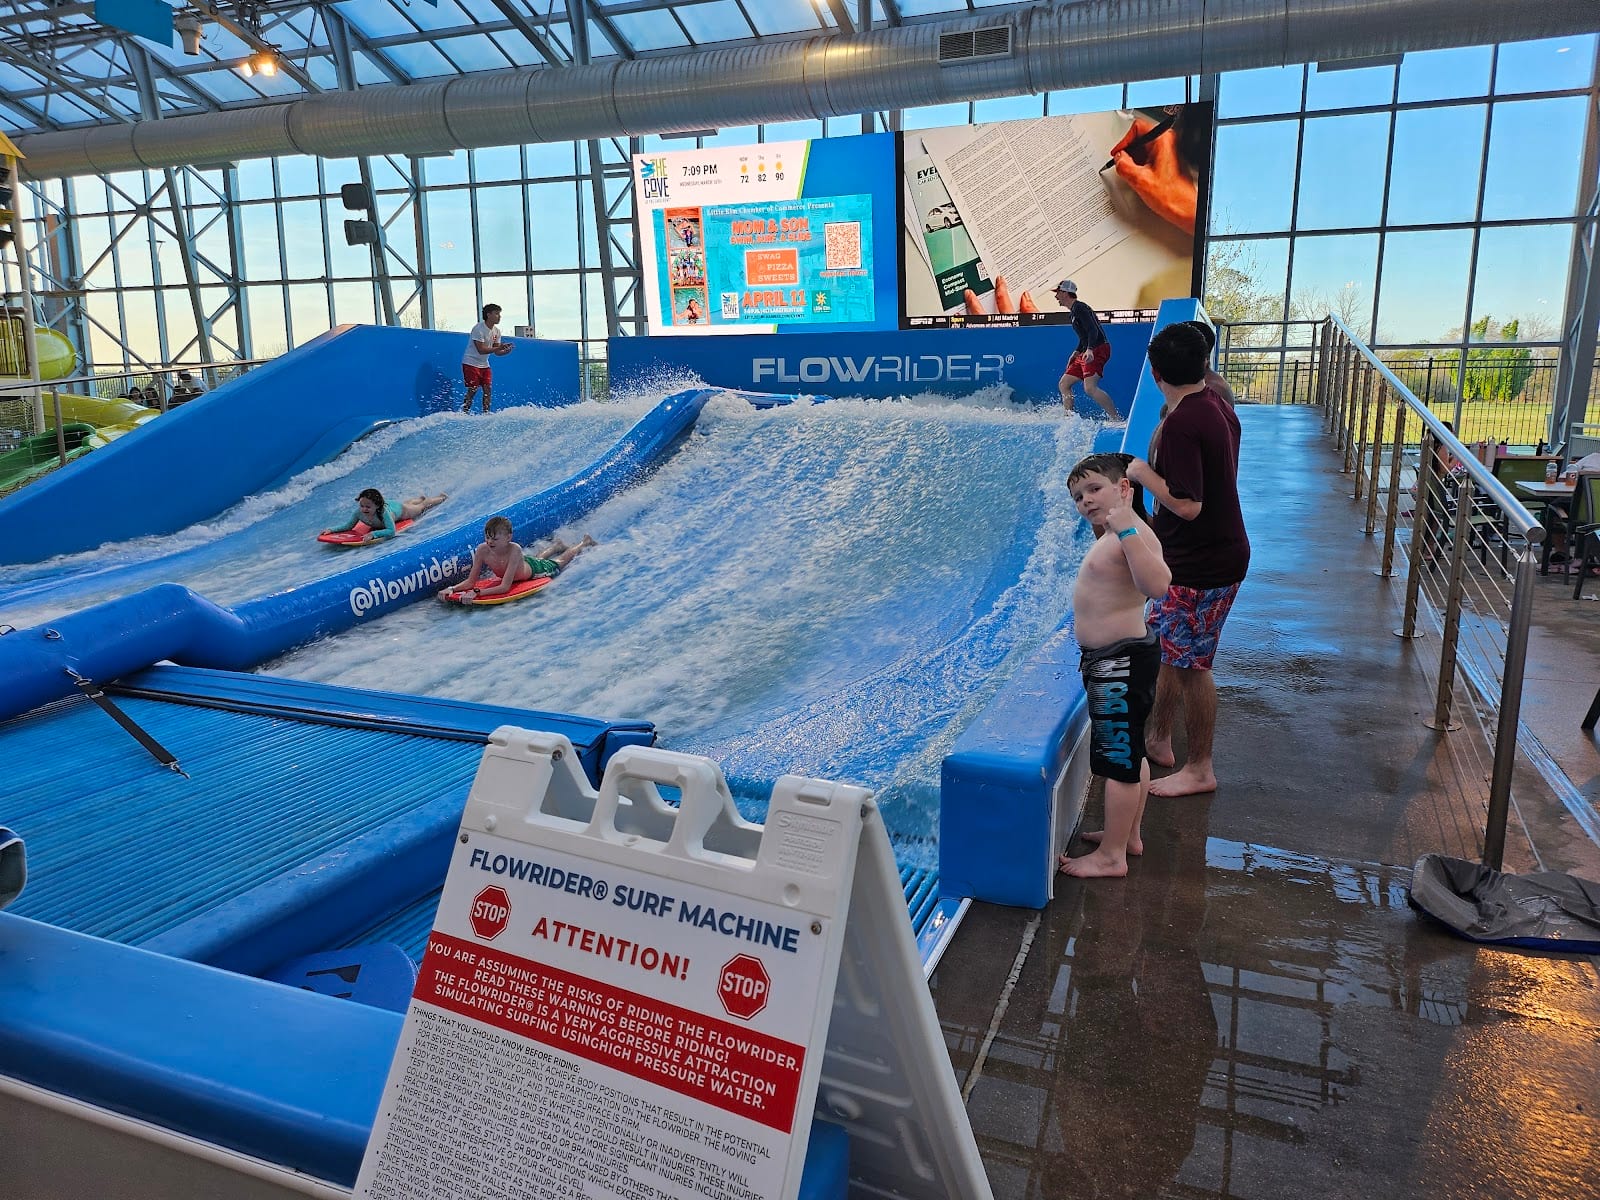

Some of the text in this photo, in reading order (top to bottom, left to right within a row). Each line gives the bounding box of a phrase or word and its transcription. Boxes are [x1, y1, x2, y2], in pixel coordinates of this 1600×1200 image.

[644, 177, 670, 198] COVE
[682, 164, 718, 177] 7:09 PM
[740, 175, 749, 184] 72
[757, 174, 767, 182] 82
[775, 172, 785, 181] 90
[732, 217, 809, 235] MOM & SON
[758, 273, 796, 282] SWEETS
[767, 263, 794, 271] PIZZA
[742, 289, 807, 308] APRIL 11
[1098, 682, 1129, 714] DO
[1101, 719, 1133, 769] JUST
[473, 900, 507, 924] STOP
[612, 883, 674, 919] SURF
[678, 900, 800, 953] MACHINE
[531, 915, 690, 981] ATTENTION!
[427, 940, 800, 1072] YOU ARE ASSUMING THE RISKS OF RIDING THE FLOWRIDER.
[722, 971, 765, 1001] STOP
[433, 969, 455, 985] THE
[536, 1003, 548, 1017] IS
[551, 1008, 561, 1021] A
[563, 1012, 596, 1033] VERY
[598, 1024, 681, 1063] AGGRESSIVE
[684, 1054, 776, 1096] ATTRACTION
[473, 968, 729, 1063] READ THESE WARNINGS BEFORE RIDING!
[412, 1006, 580, 1074] THINGS THAT YOU SHOULD KNOW BEFORE RIDING:
[434, 983, 767, 1110] SIMULATING SURFING USINGHIGH PRESSURE WATER.
[414, 1037, 438, 1052] WATER
[438, 1046, 446, 1055] IS
[526, 1080, 543, 1093] AND
[543, 1087, 558, 1099] THE
[558, 1093, 576, 1106] RIDE
[576, 1099, 611, 1120] SURFACE
[611, 1113, 620, 1123] IS
[620, 1116, 641, 1131] FIRM.
[416, 1028, 430, 1039] FOR
[430, 1033, 455, 1049] SEVERE
[455, 1043, 491, 1062] PERSONAL
[491, 1056, 515, 1071] INJURY
[515, 1065, 543, 1082] DURING
[543, 1076, 564, 1090] YOUR
[621, 1106, 634, 1117] ON
[635, 1111, 651, 1124] THE
[702, 1136, 720, 1151] THE
[721, 1143, 756, 1164] MOVING
[419, 1019, 434, 1030] YOU
[434, 1024, 450, 1036] WILL
[450, 1030, 467, 1043] FALL
[544, 1065, 576, 1084] ACHIEVE
[576, 1077, 598, 1092] BODY
[640, 1101, 662, 1116] THAT
[662, 1109, 694, 1128] RESULT
[694, 1121, 704, 1132] IN
[704, 1125, 722, 1139] THE
[411, 1047, 430, 1060] BODY
[465, 1068, 483, 1081] THAT
[485, 1075, 500, 1088] YOU
[500, 1081, 516, 1094] MAY
[516, 1088, 547, 1107] ACHIEVE
[548, 1100, 585, 1121] WHETHER
[645, 1138, 658, 1151] OR
[727, 1171, 749, 1187] WILL
[395, 1103, 418, 1119] WHICH
[418, 1113, 434, 1126] MAY
[433, 1119, 458, 1136] OCCUR
[506, 1150, 516, 1161] OF
[517, 1155, 538, 1171] YOUR
[537, 1164, 558, 1179] SKILL
[558, 1173, 585, 1191] LEVEL).
[375, 1169, 430, 1200] WITH THEM MAY
[380, 1150, 463, 1194] SINCE THE RIDE VEHICLES
